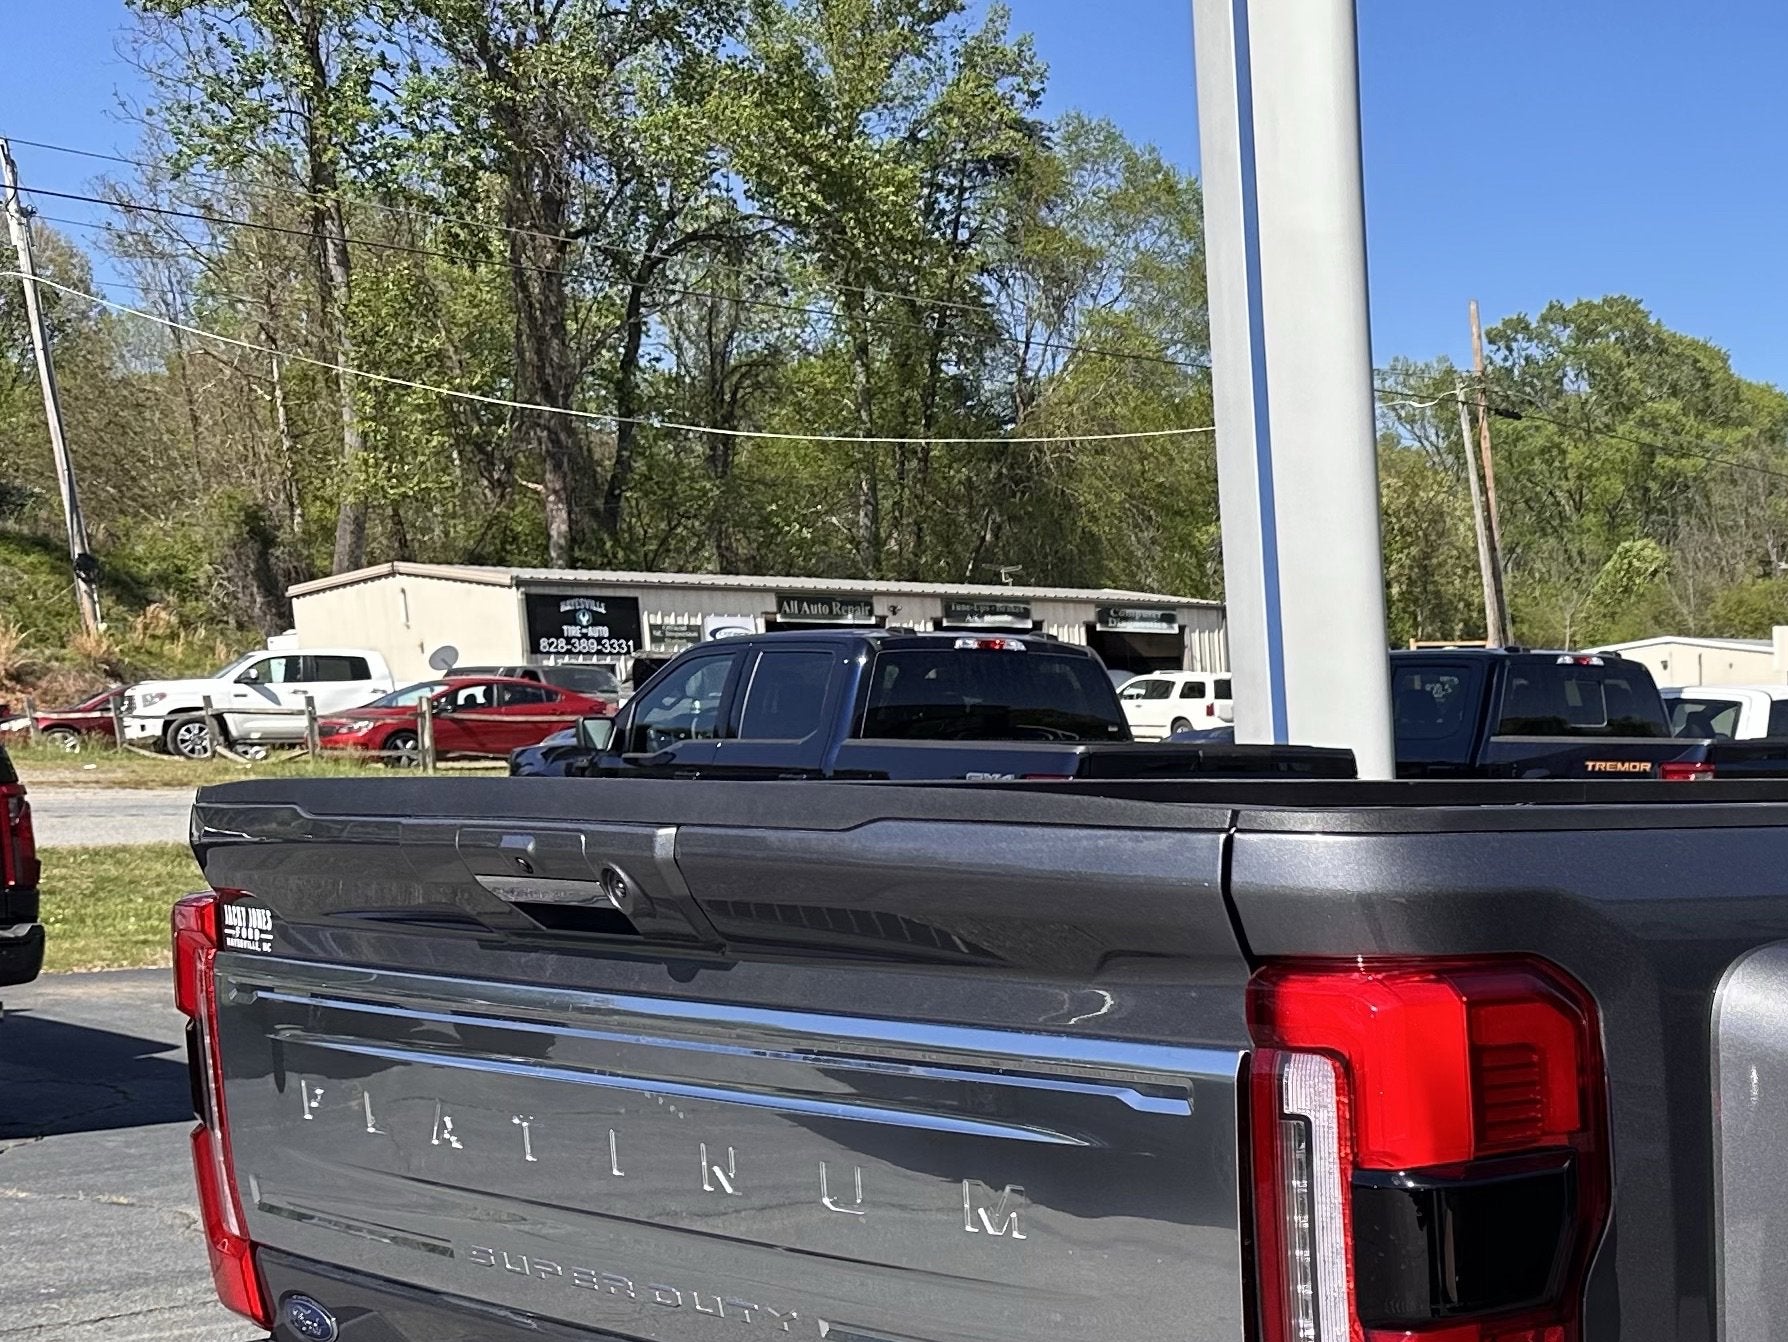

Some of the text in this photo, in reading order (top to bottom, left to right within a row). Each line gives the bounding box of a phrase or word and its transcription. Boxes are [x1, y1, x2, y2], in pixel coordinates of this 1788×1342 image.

[781, 601, 871, 617] All Auto Repair
[539, 637, 634, 653] 828-389-3331
[1585, 761, 1652, 772] TREMOR
[223, 904, 273, 931] JACKY JONES
[300, 1079, 1026, 1240] PLATINUM
[469, 1244, 799, 1332] SUPER DUTY
